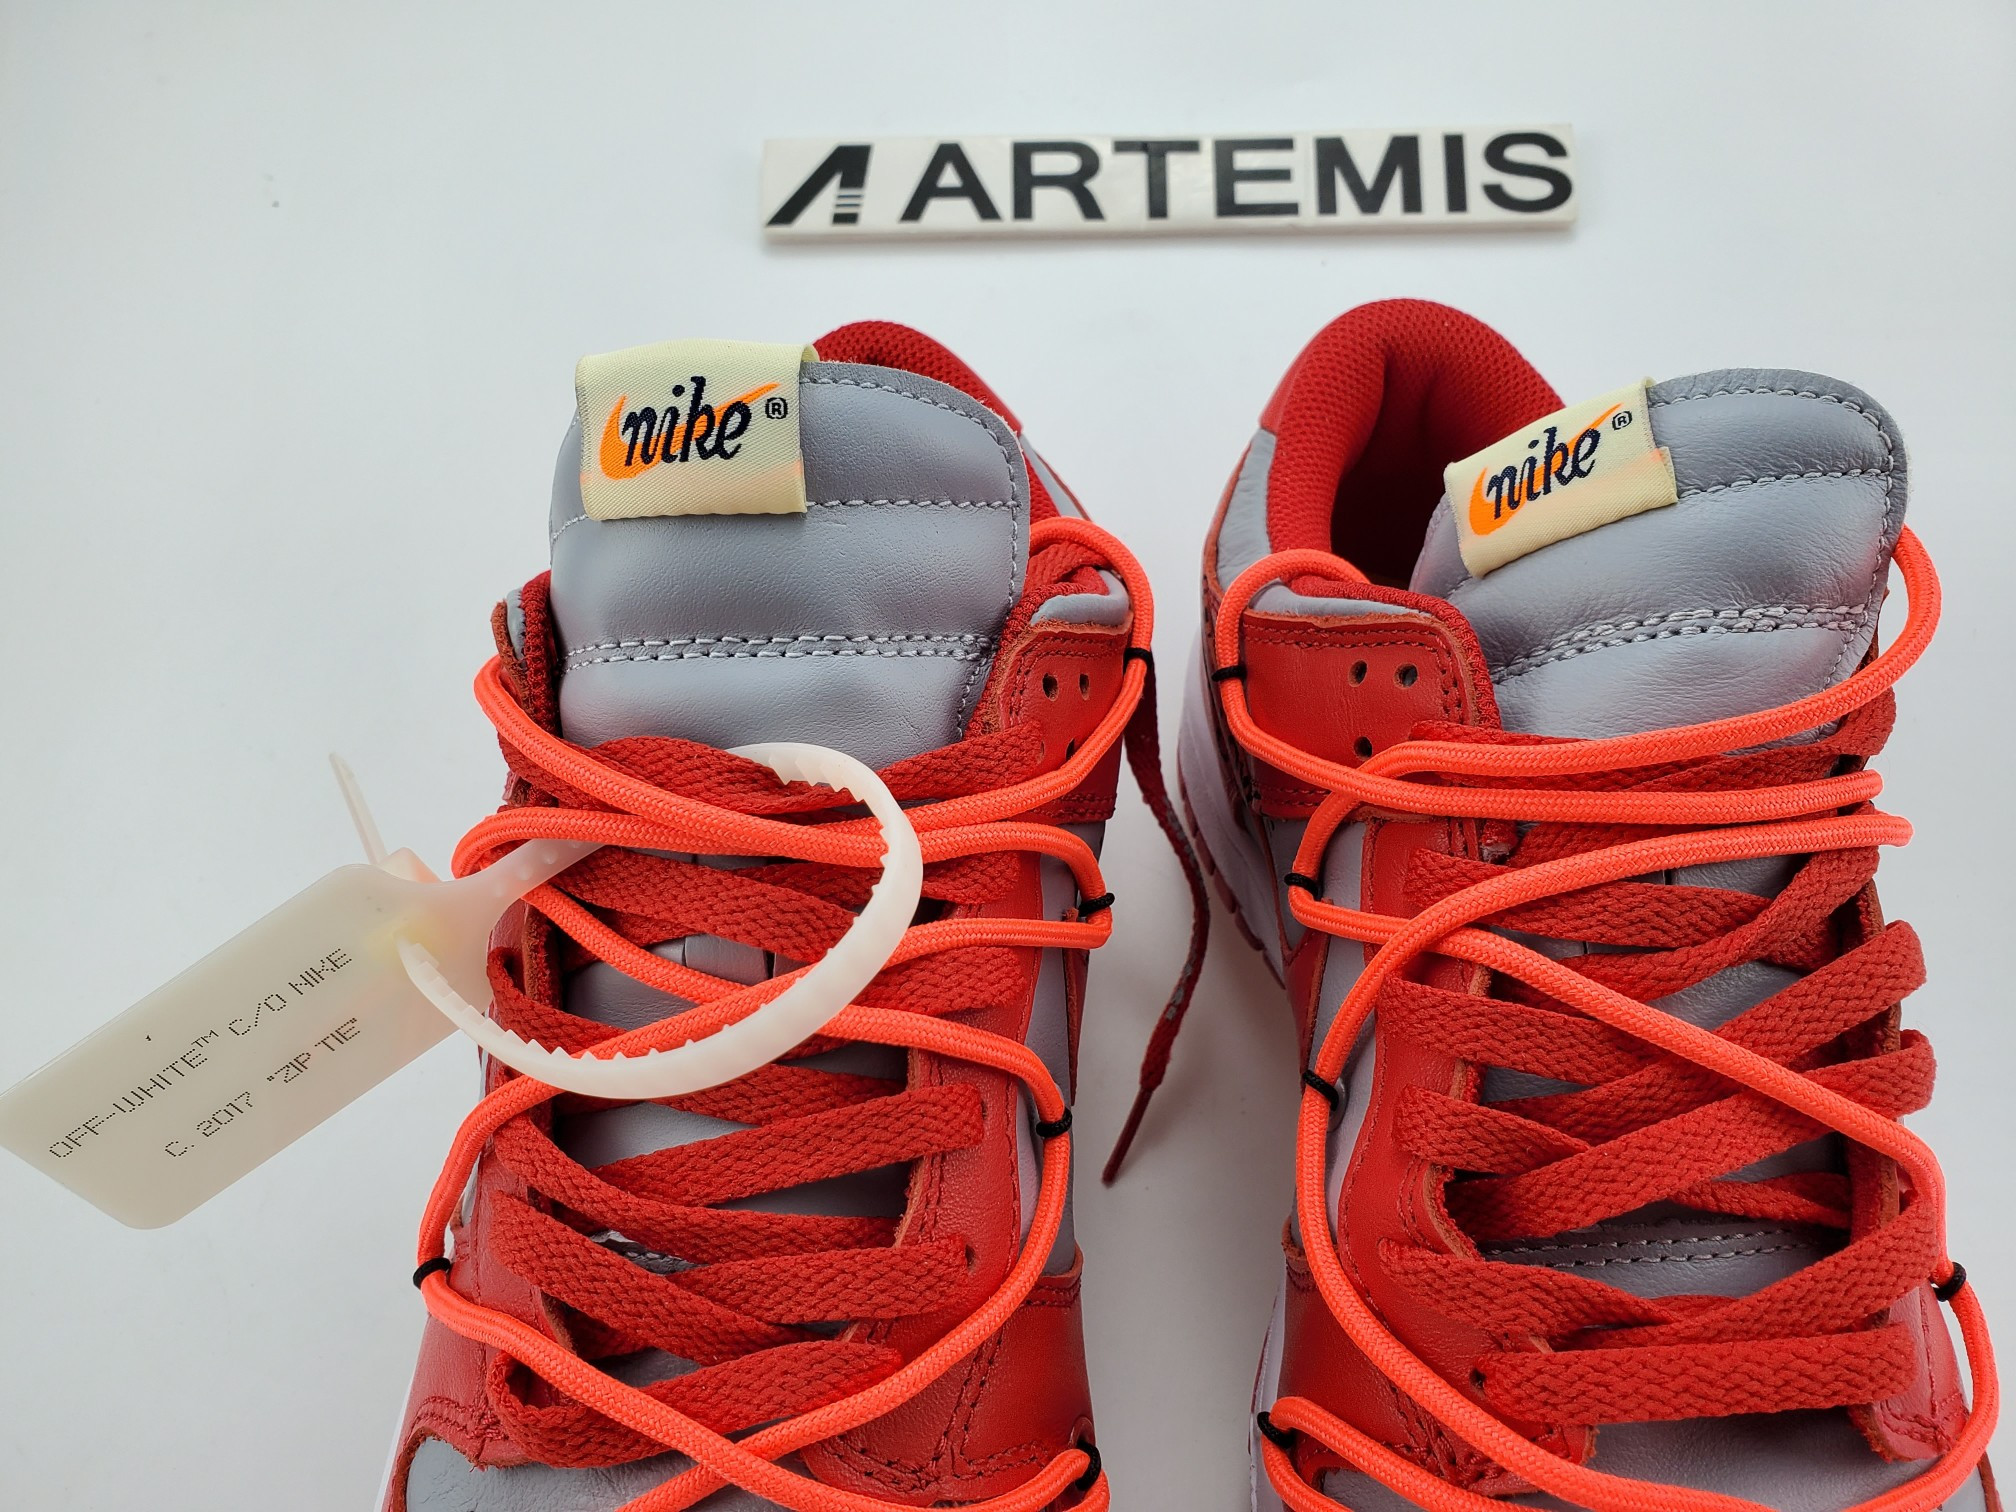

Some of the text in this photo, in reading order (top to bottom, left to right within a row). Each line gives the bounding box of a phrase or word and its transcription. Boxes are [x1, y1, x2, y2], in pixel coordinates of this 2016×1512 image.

[899, 131, 1573, 222] ARTEMIS
[228, 993, 287, 1036] C/O
[288, 948, 352, 995] NIKE
[165, 1140, 195, 1157] C.
[196, 1091, 253, 1137] 2017
